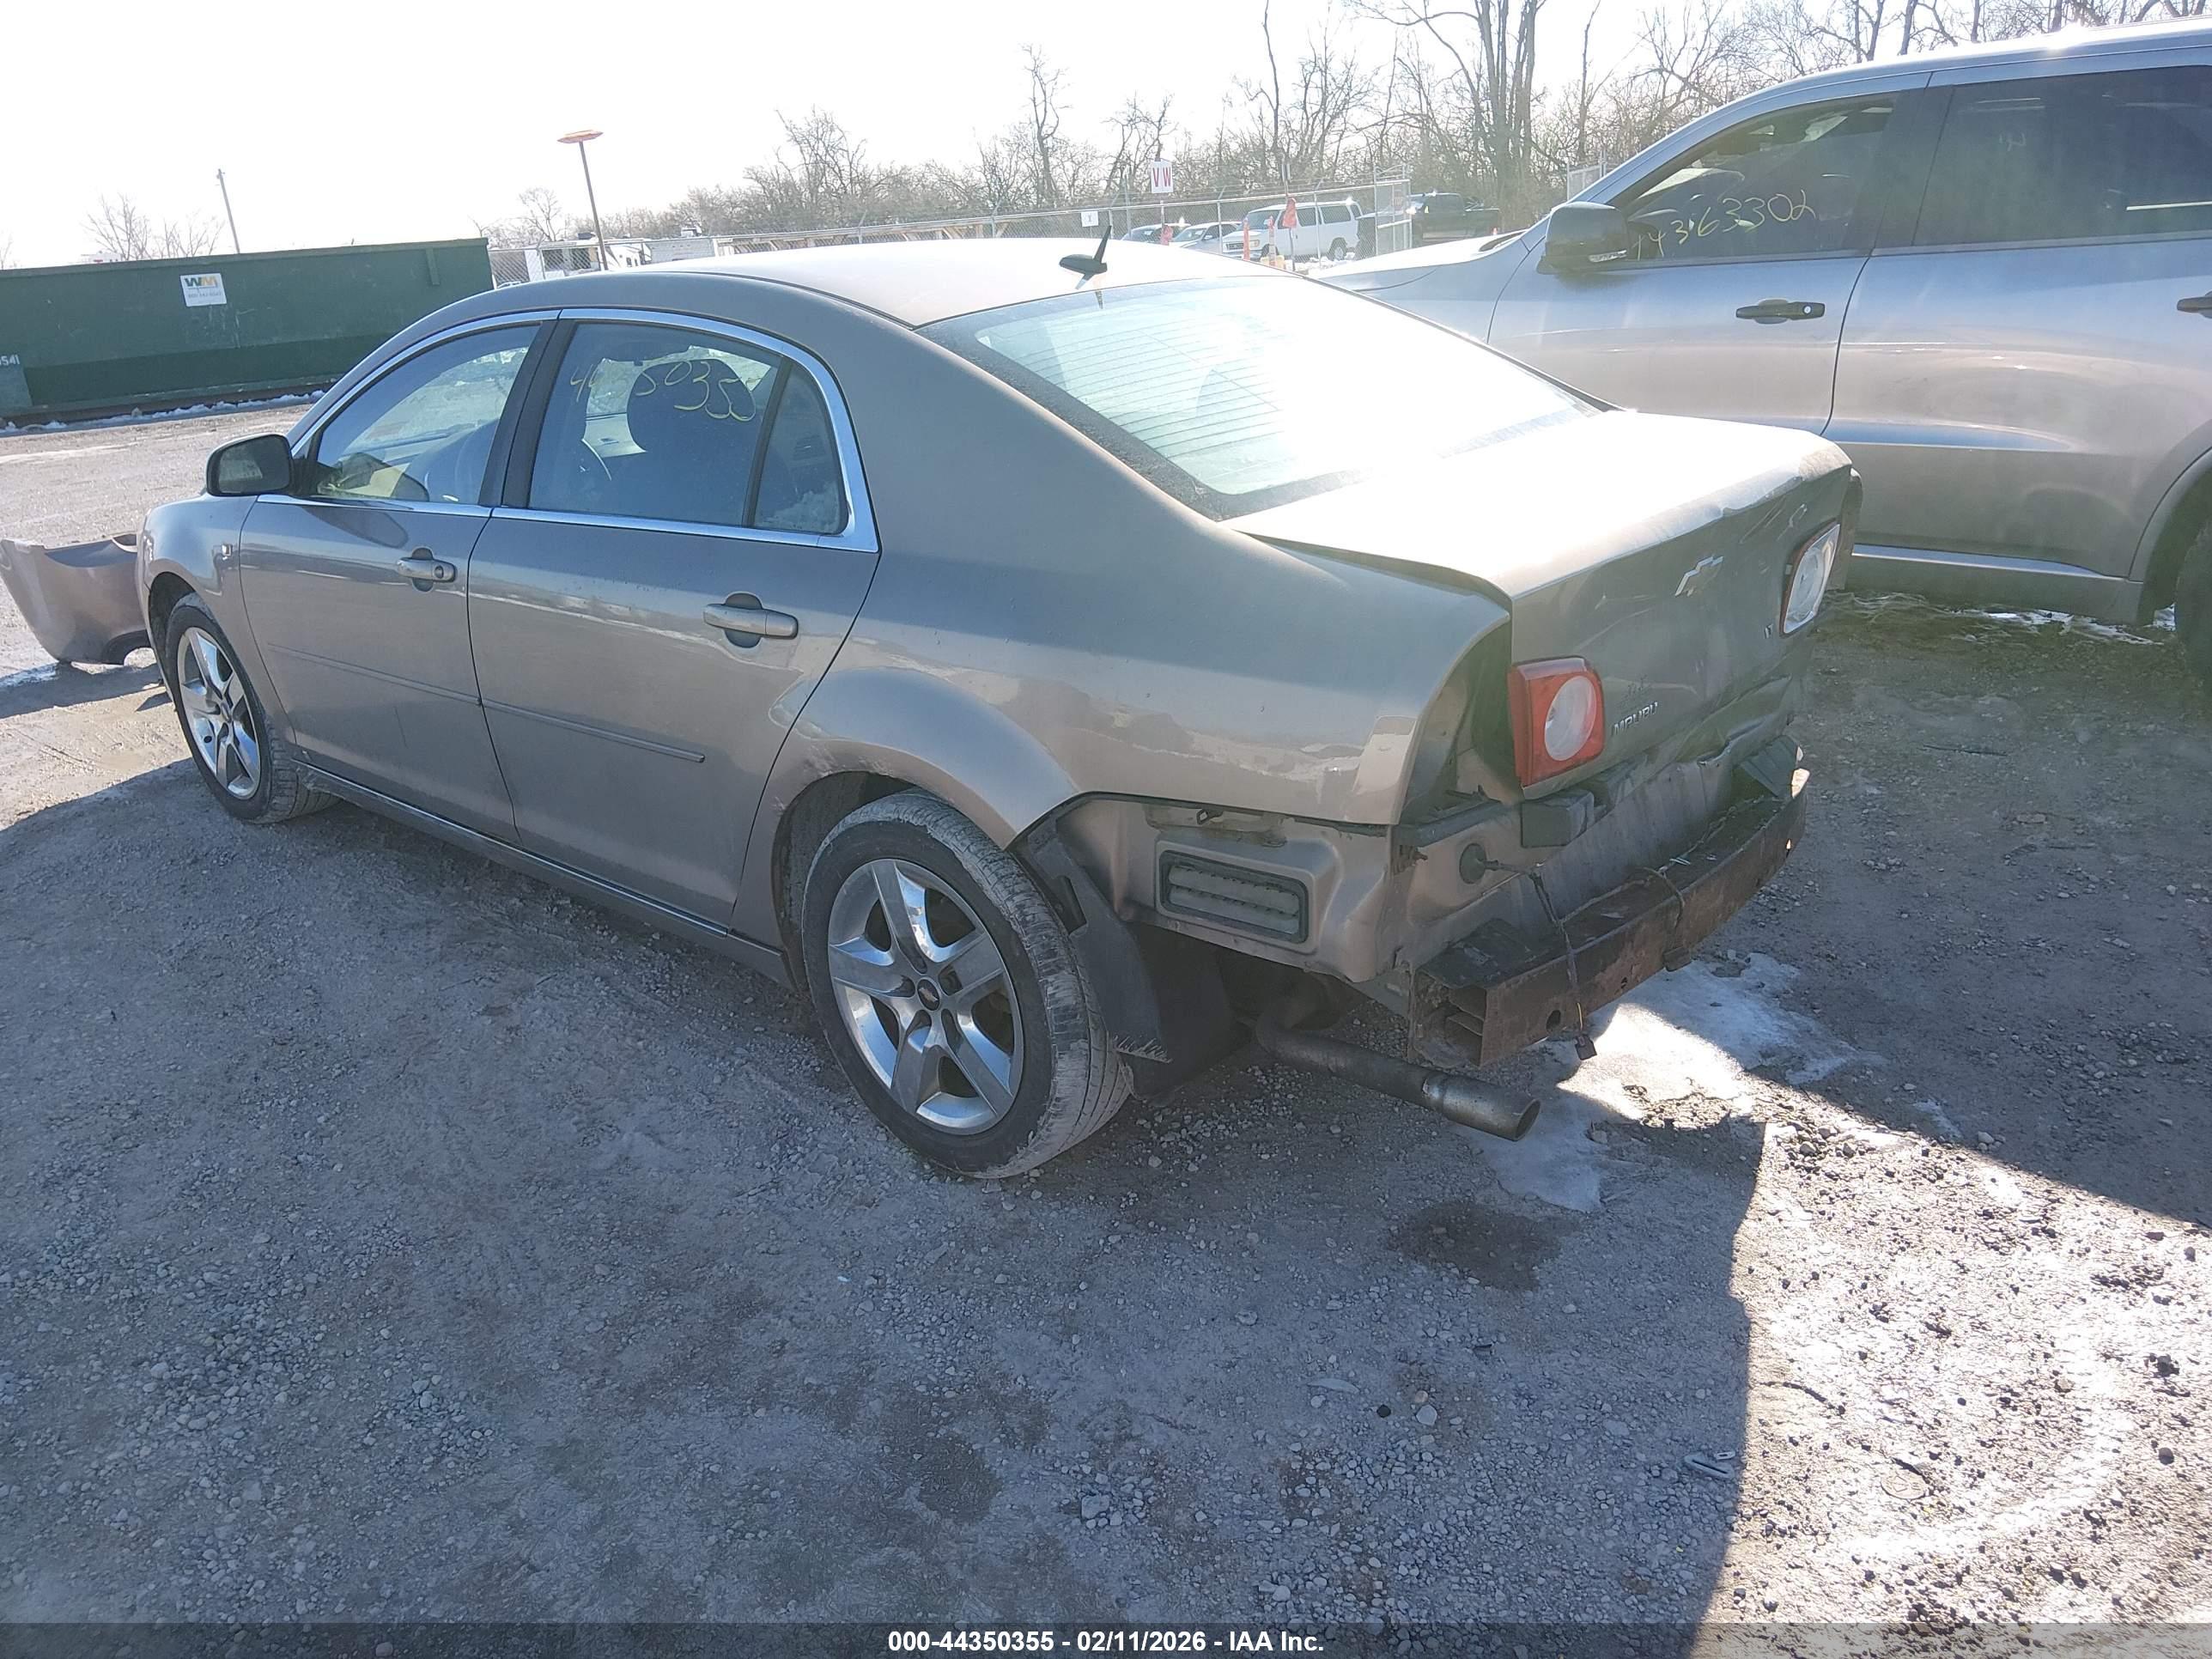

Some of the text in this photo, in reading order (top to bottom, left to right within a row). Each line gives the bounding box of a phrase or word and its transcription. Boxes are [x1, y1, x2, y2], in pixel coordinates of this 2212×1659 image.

[184, 276, 218, 288] WM
[0, 354, 21, 366] 541
[1612, 701, 1658, 735] MALIBU
